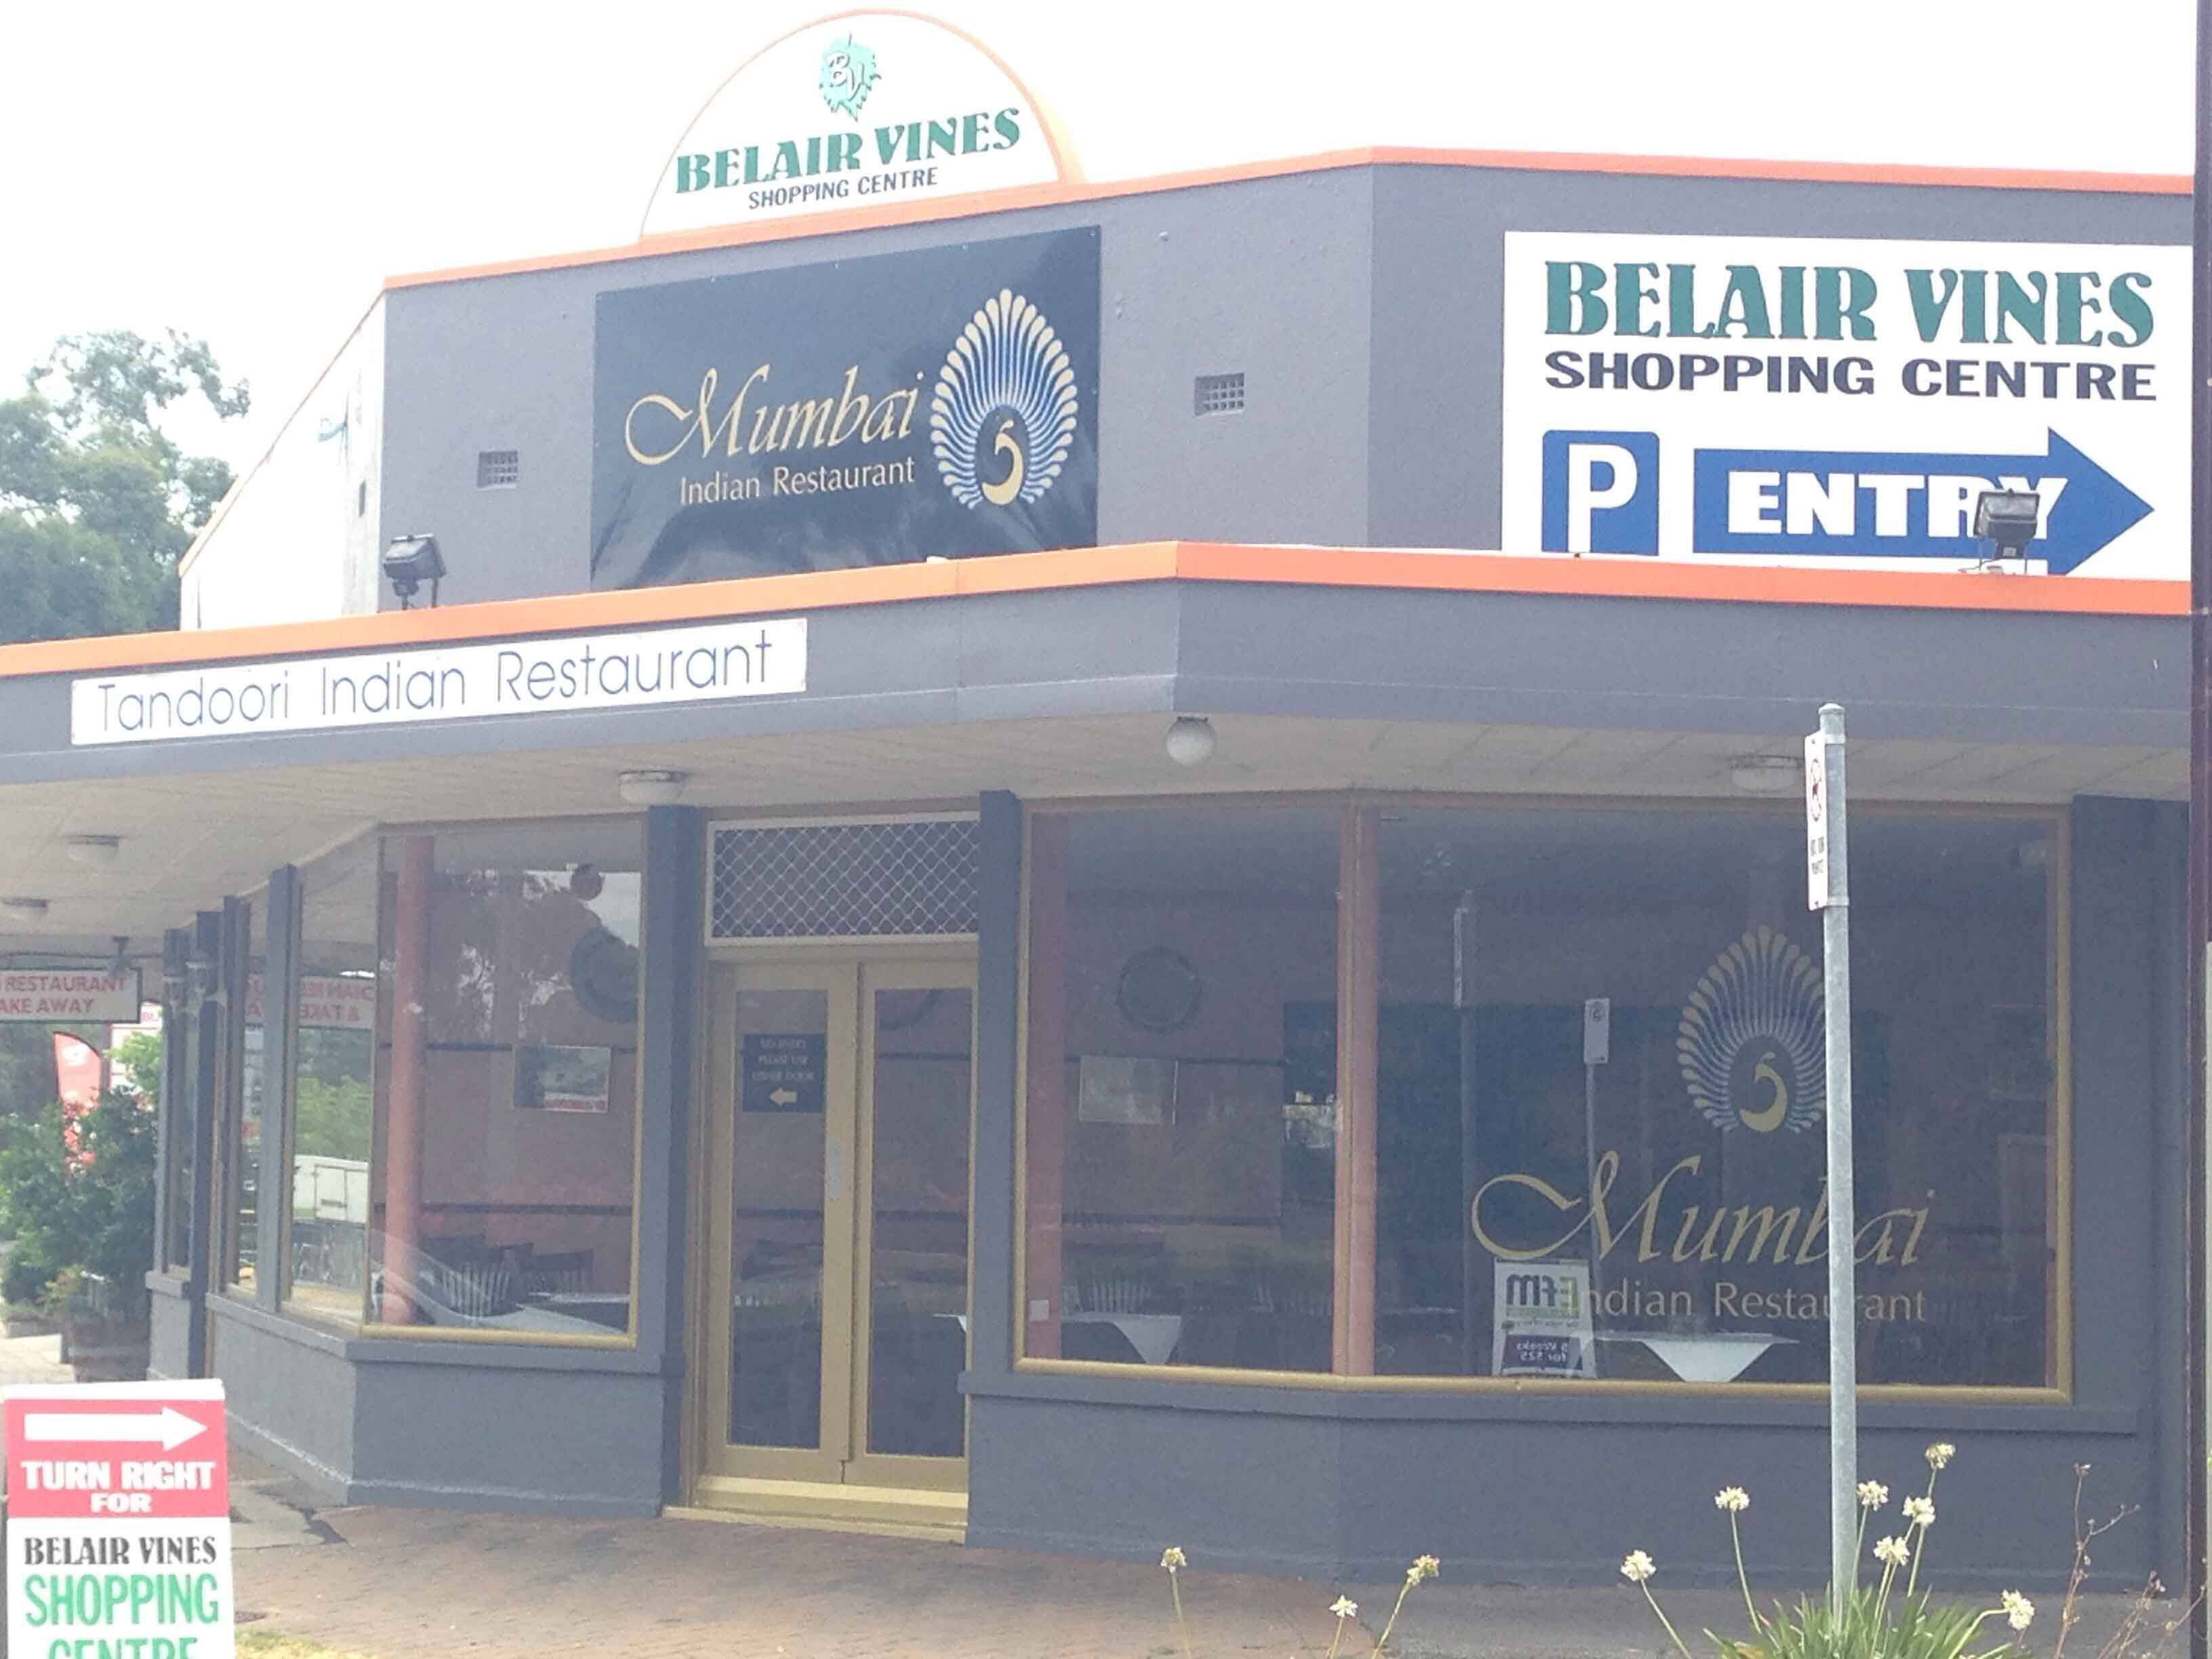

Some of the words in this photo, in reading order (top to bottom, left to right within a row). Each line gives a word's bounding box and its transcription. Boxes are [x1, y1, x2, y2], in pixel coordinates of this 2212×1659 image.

[676, 132, 865, 193] BELAIR
[874, 108, 1021, 165] VINES
[748, 180, 850, 209] SHOPPING
[857, 167, 938, 194] CENTRE
[1544, 260, 1878, 342] BELAIR
[1903, 268, 2154, 348] VINES
[1544, 350, 1876, 396] SHOPPING
[1901, 358, 2157, 401] CENTRE
[624, 364, 924, 466] Mumbai
[680, 474, 760, 506] Indian
[773, 457, 916, 495] Restaurant
[98, 670, 290, 730] Tandoori
[320, 661, 466, 716] Indian
[497, 630, 773, 701] Restaurant
[5, 974, 128, 994] RESTAURANT
[36, 998, 96, 1015] AWAY
[20, 1461, 110, 1490] TURN
[121, 1461, 216, 1490] RIGHT
[90, 1493, 152, 1513] FOR
[24, 1537, 130, 1565] BELAIR
[139, 1536, 217, 1565] VINES
[24, 1574, 219, 1626] SHOPPING
